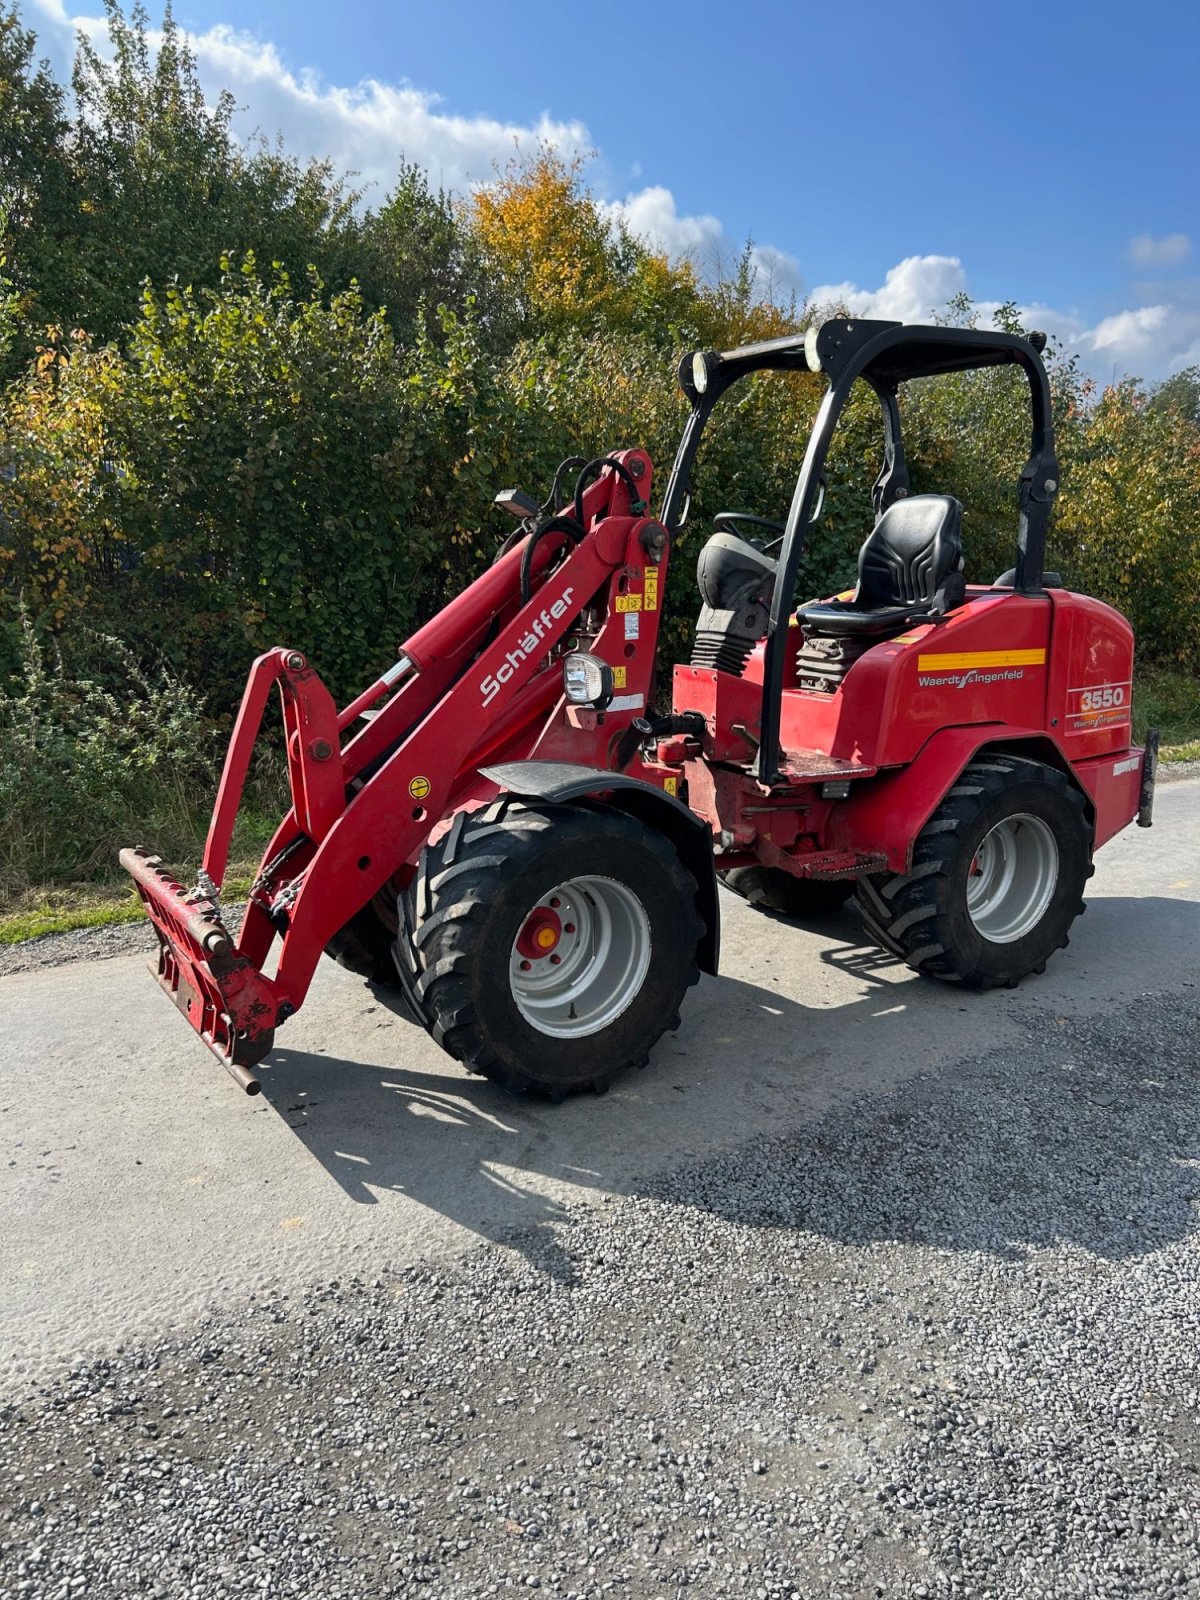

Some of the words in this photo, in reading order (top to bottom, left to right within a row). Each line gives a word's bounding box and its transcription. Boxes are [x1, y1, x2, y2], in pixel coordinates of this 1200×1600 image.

[480, 587, 574, 708] Schäffer
[919, 675, 960, 687] Waerdt
[975, 669, 1023, 684] Ingenfeld
[1081, 687, 1124, 711] 3550
